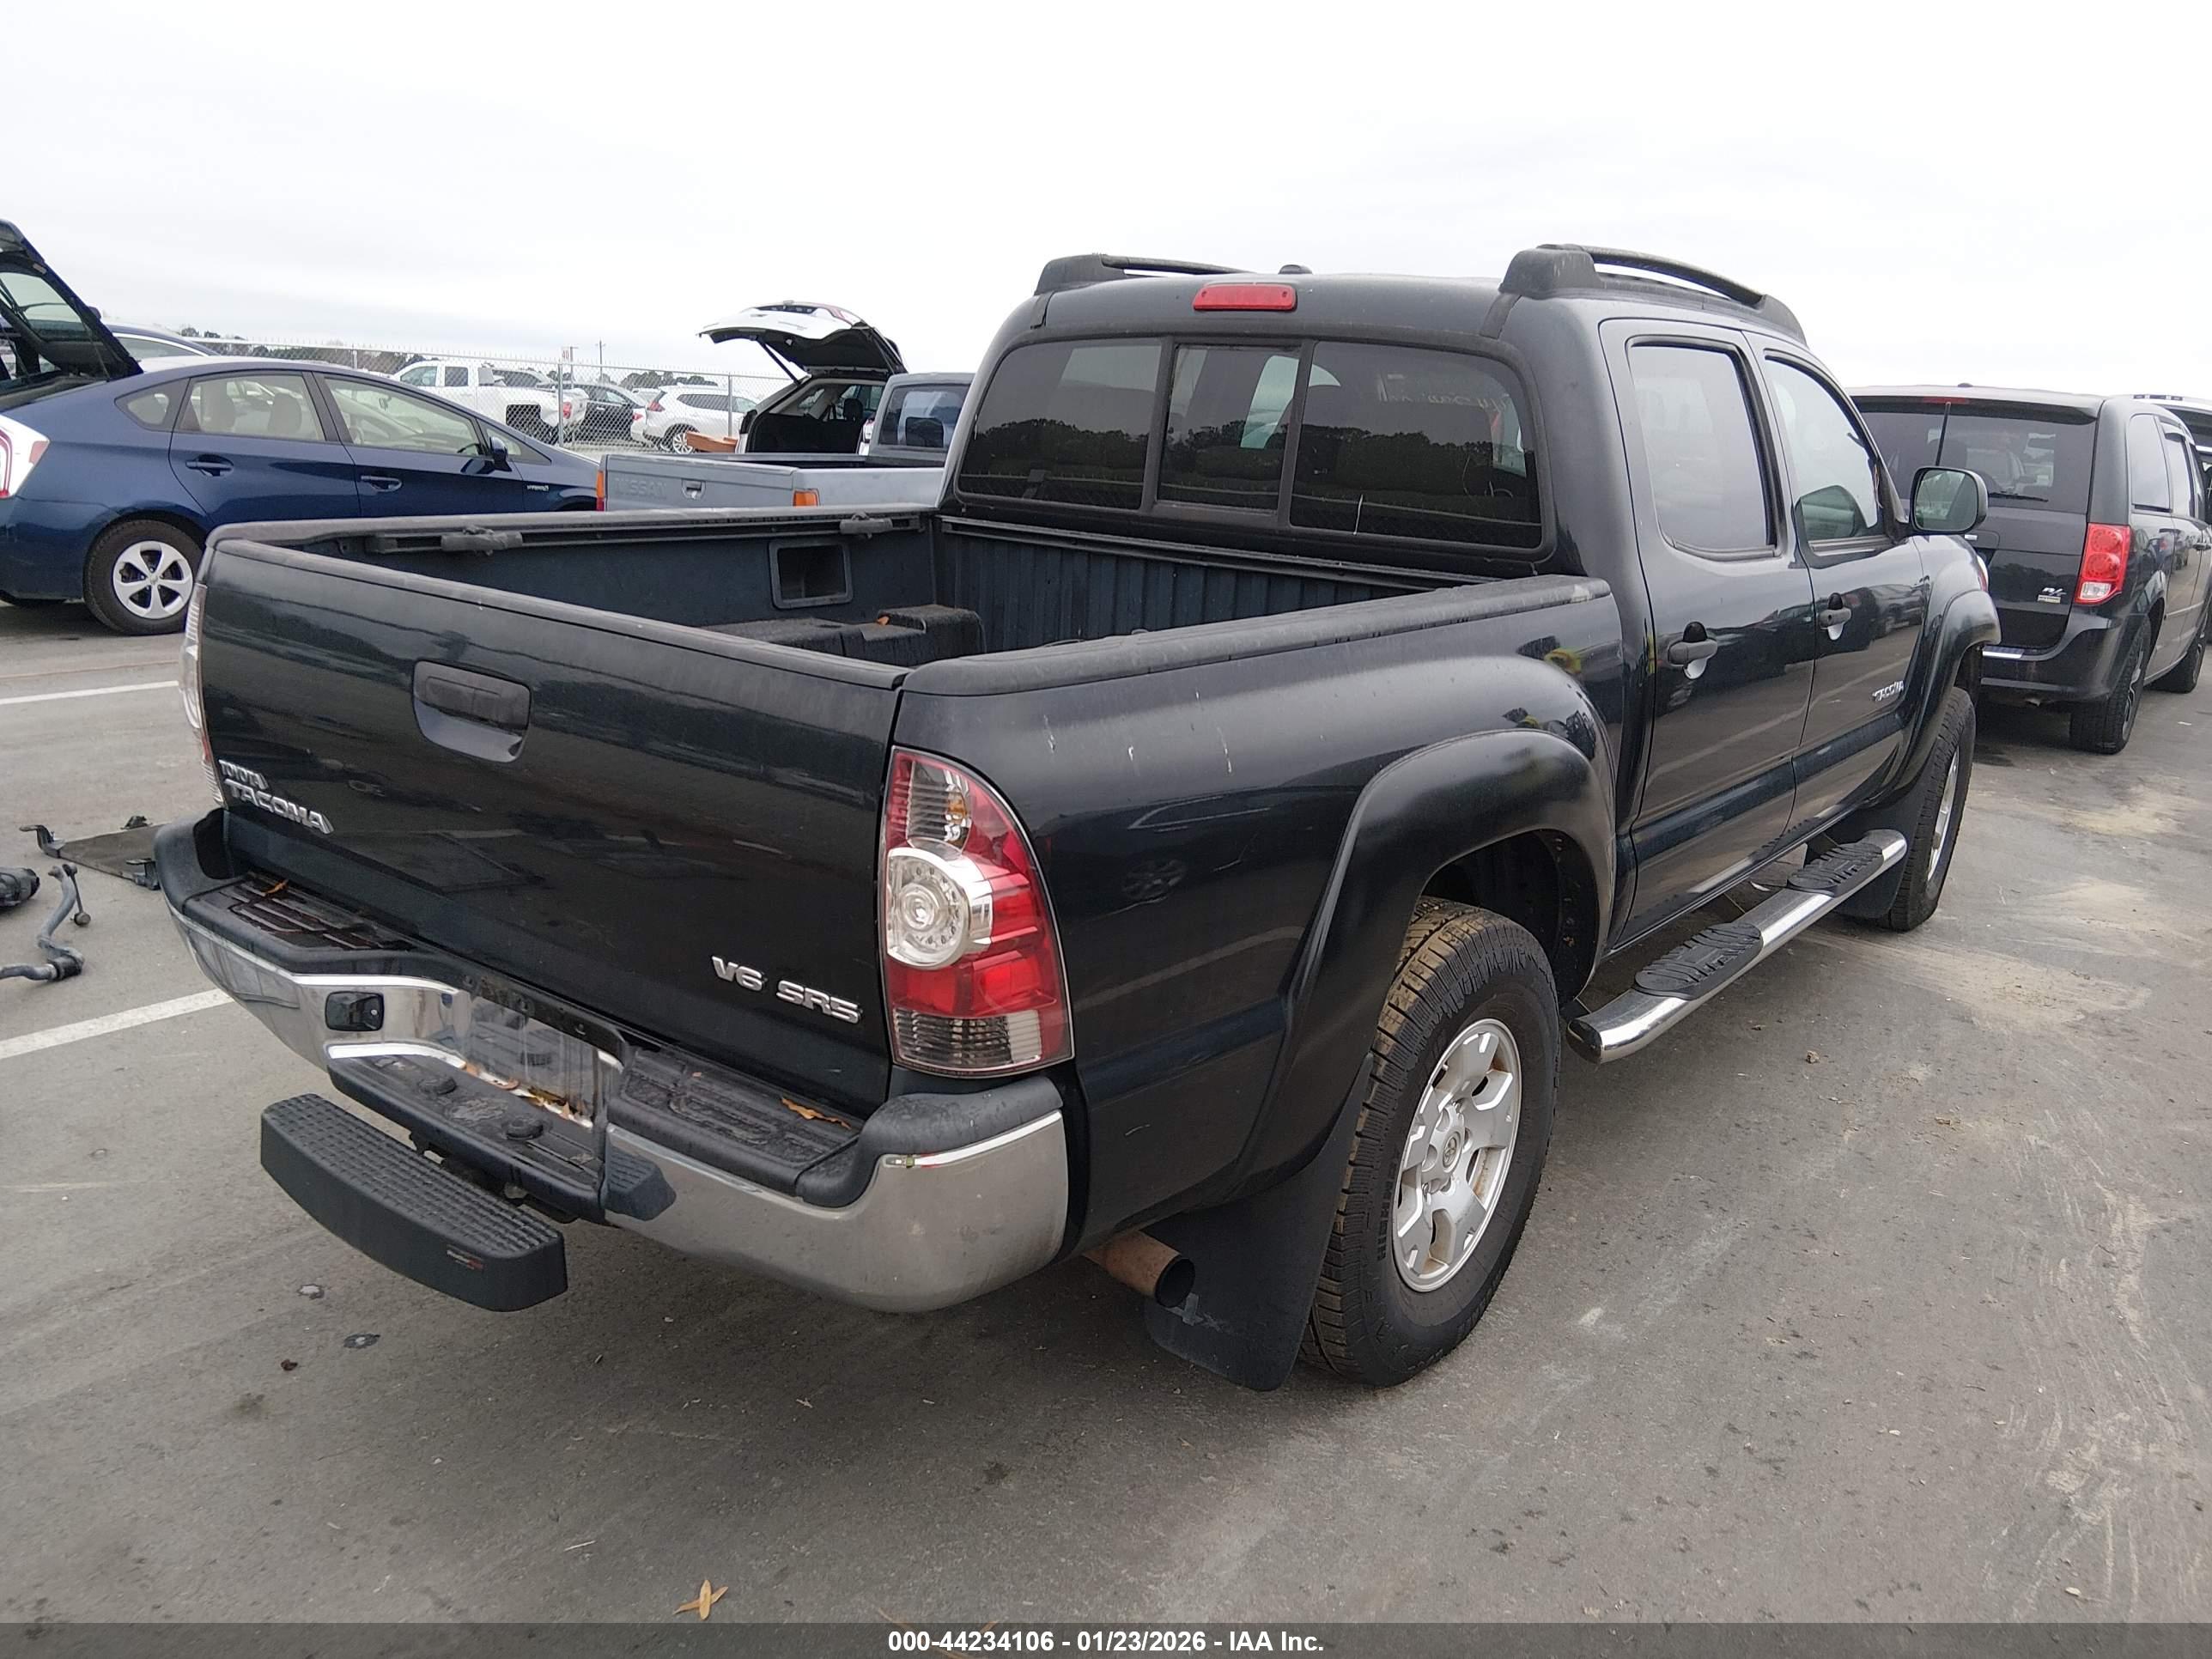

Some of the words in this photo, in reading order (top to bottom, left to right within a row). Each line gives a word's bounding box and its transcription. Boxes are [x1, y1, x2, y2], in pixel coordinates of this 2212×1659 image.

[218, 758, 270, 790] TOYOTA
[224, 777, 335, 835] TACOMA
[711, 955, 765, 992] V6
[775, 980, 861, 1024] SR5
